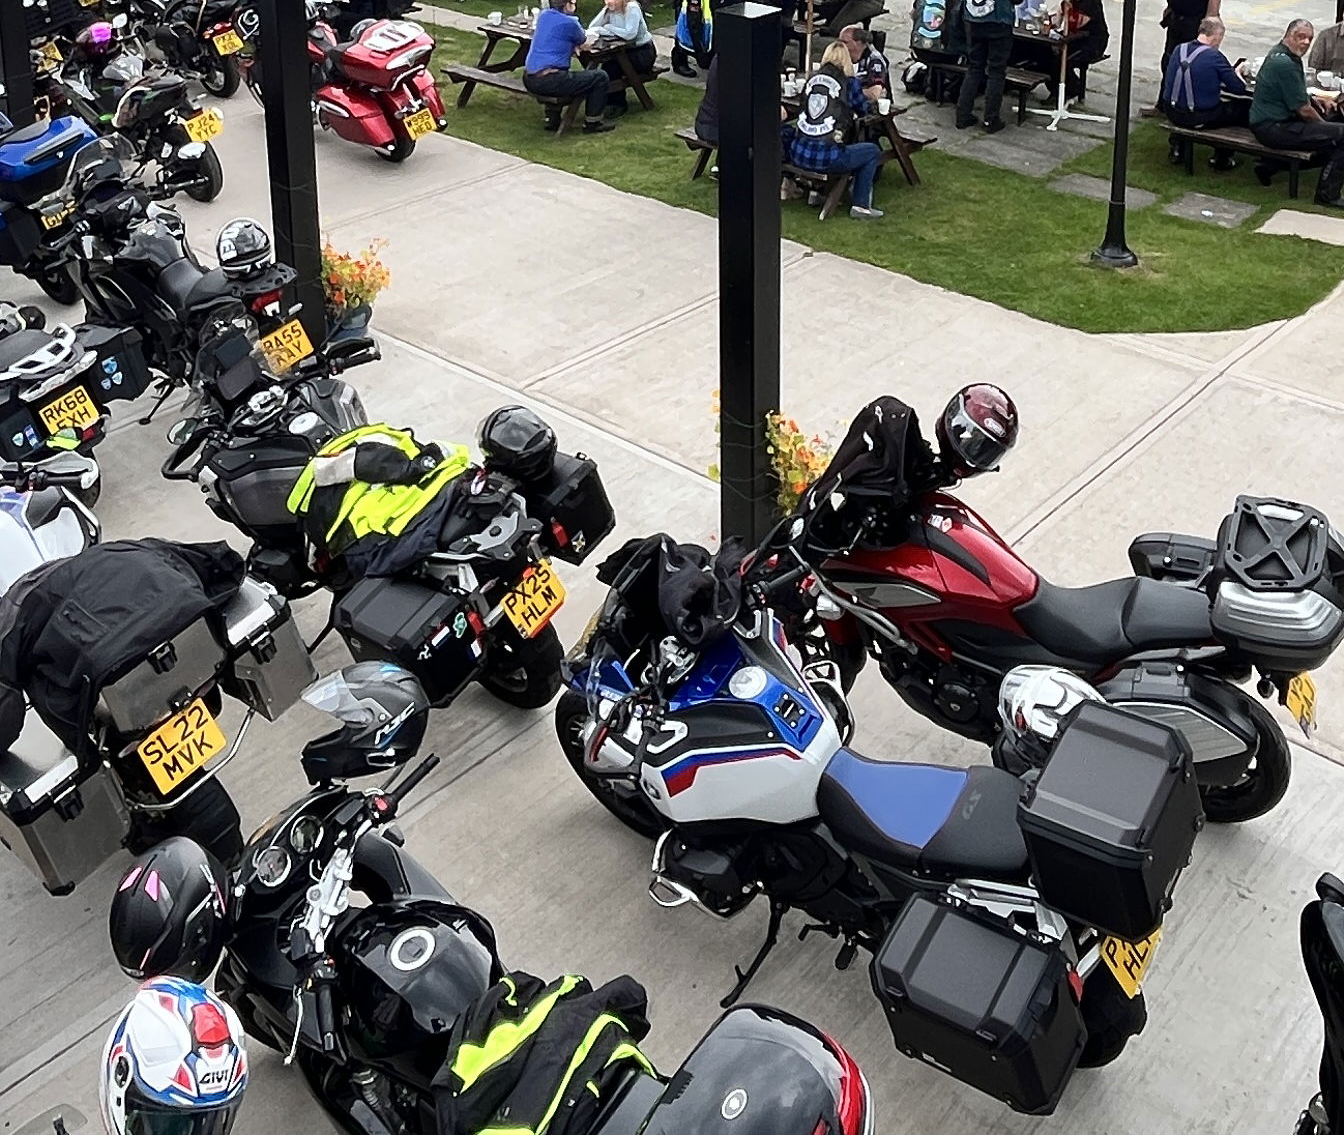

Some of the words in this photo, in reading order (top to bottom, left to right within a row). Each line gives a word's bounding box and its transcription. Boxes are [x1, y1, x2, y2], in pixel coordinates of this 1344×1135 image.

[42, 388, 88, 425] RK68
[504, 563, 551, 616] PX25
[521, 585, 558, 628] HLM
[142, 704, 209, 765] SL22
[162, 730, 213, 781] MVK
[199, 1069, 230, 1085] GIVI
